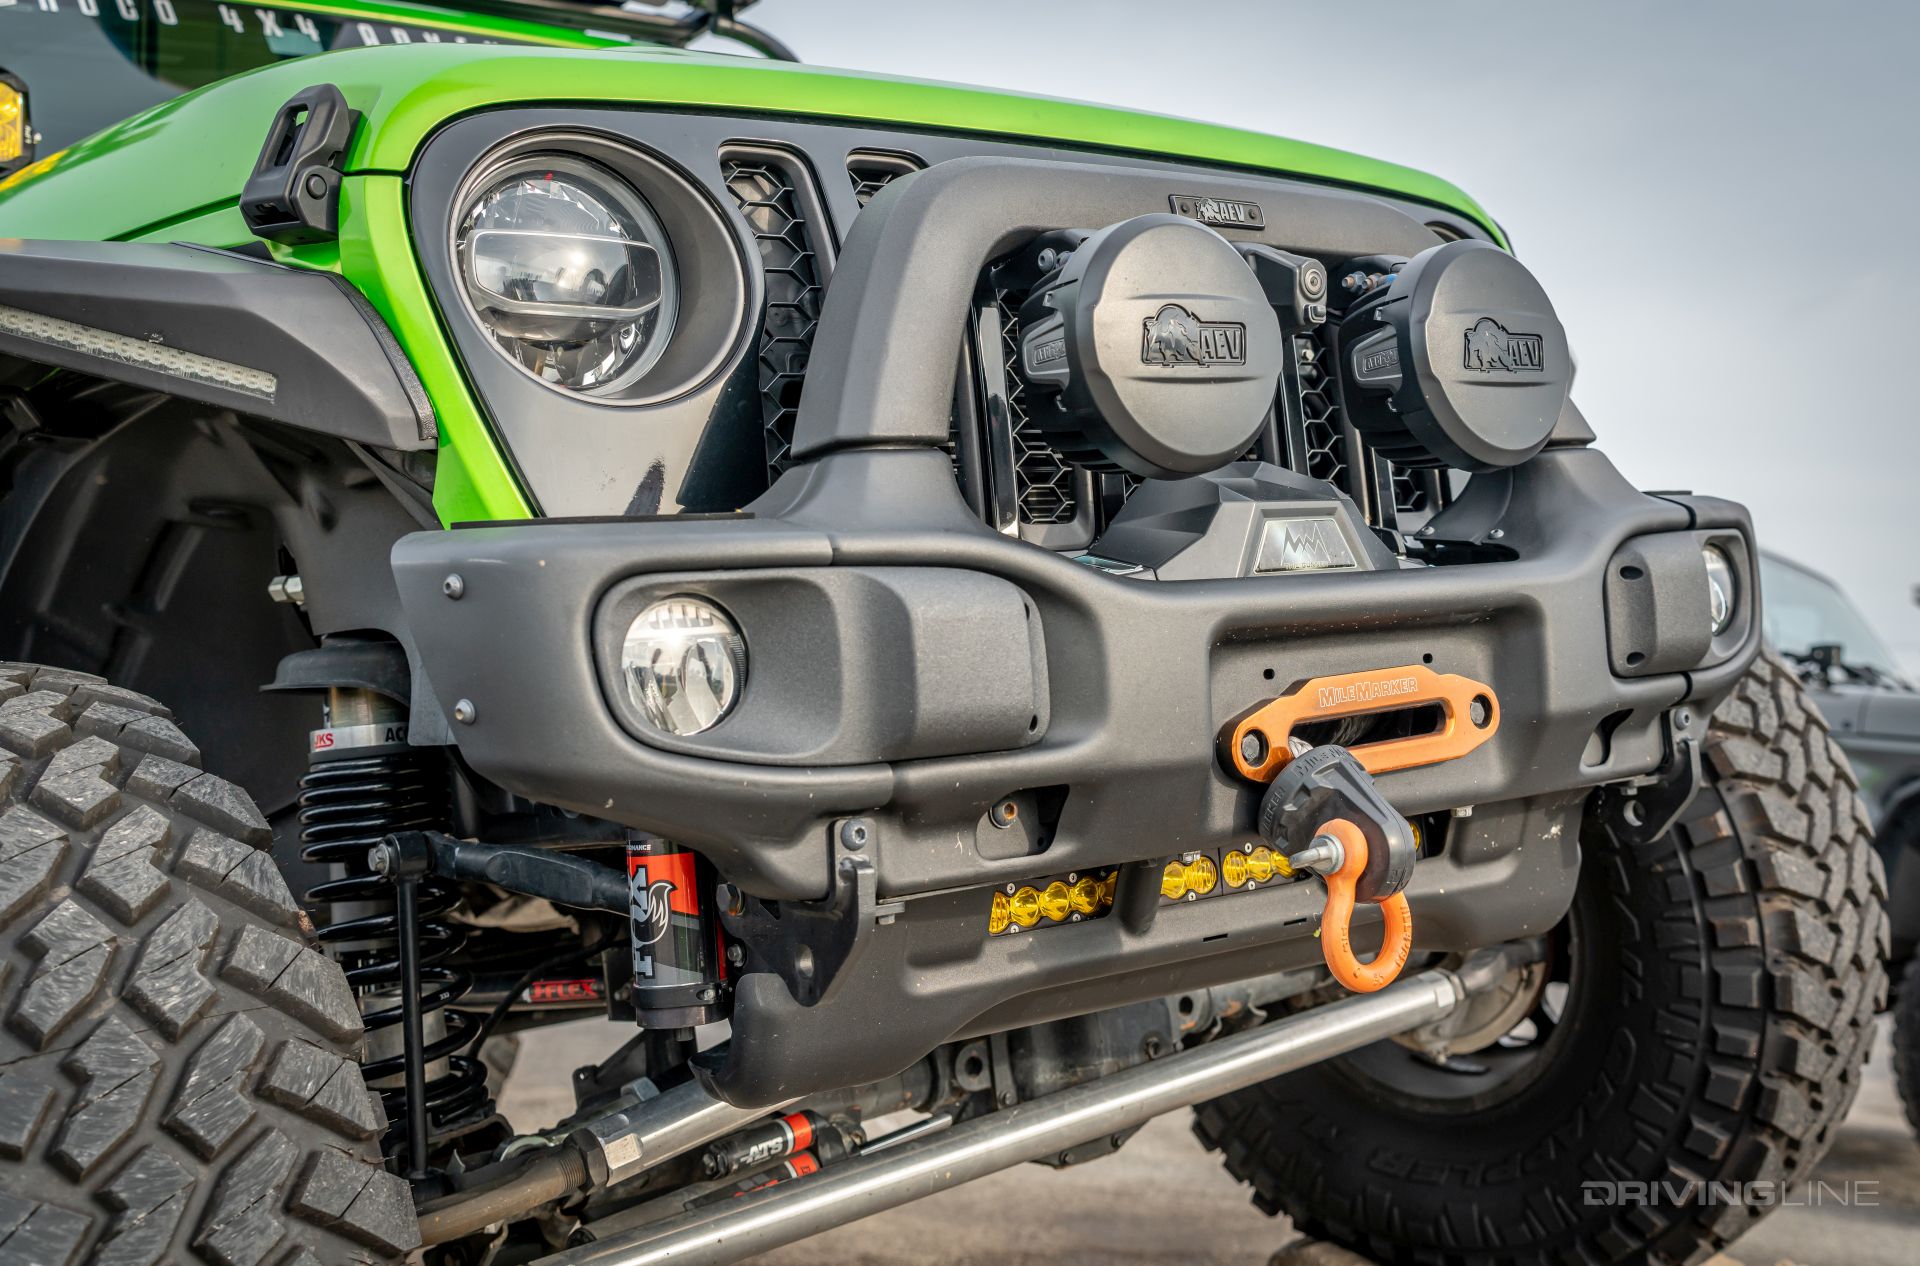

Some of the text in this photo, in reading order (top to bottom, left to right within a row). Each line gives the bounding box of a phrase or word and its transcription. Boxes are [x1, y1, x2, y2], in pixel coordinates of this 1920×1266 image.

[1219, 202, 1245, 222] AEV
[1202, 328, 1241, 360] AEV
[1508, 338, 1540, 367] AEV
[314, 732, 335, 749] JKS
[744, 1136, 784, 1164] ATS
